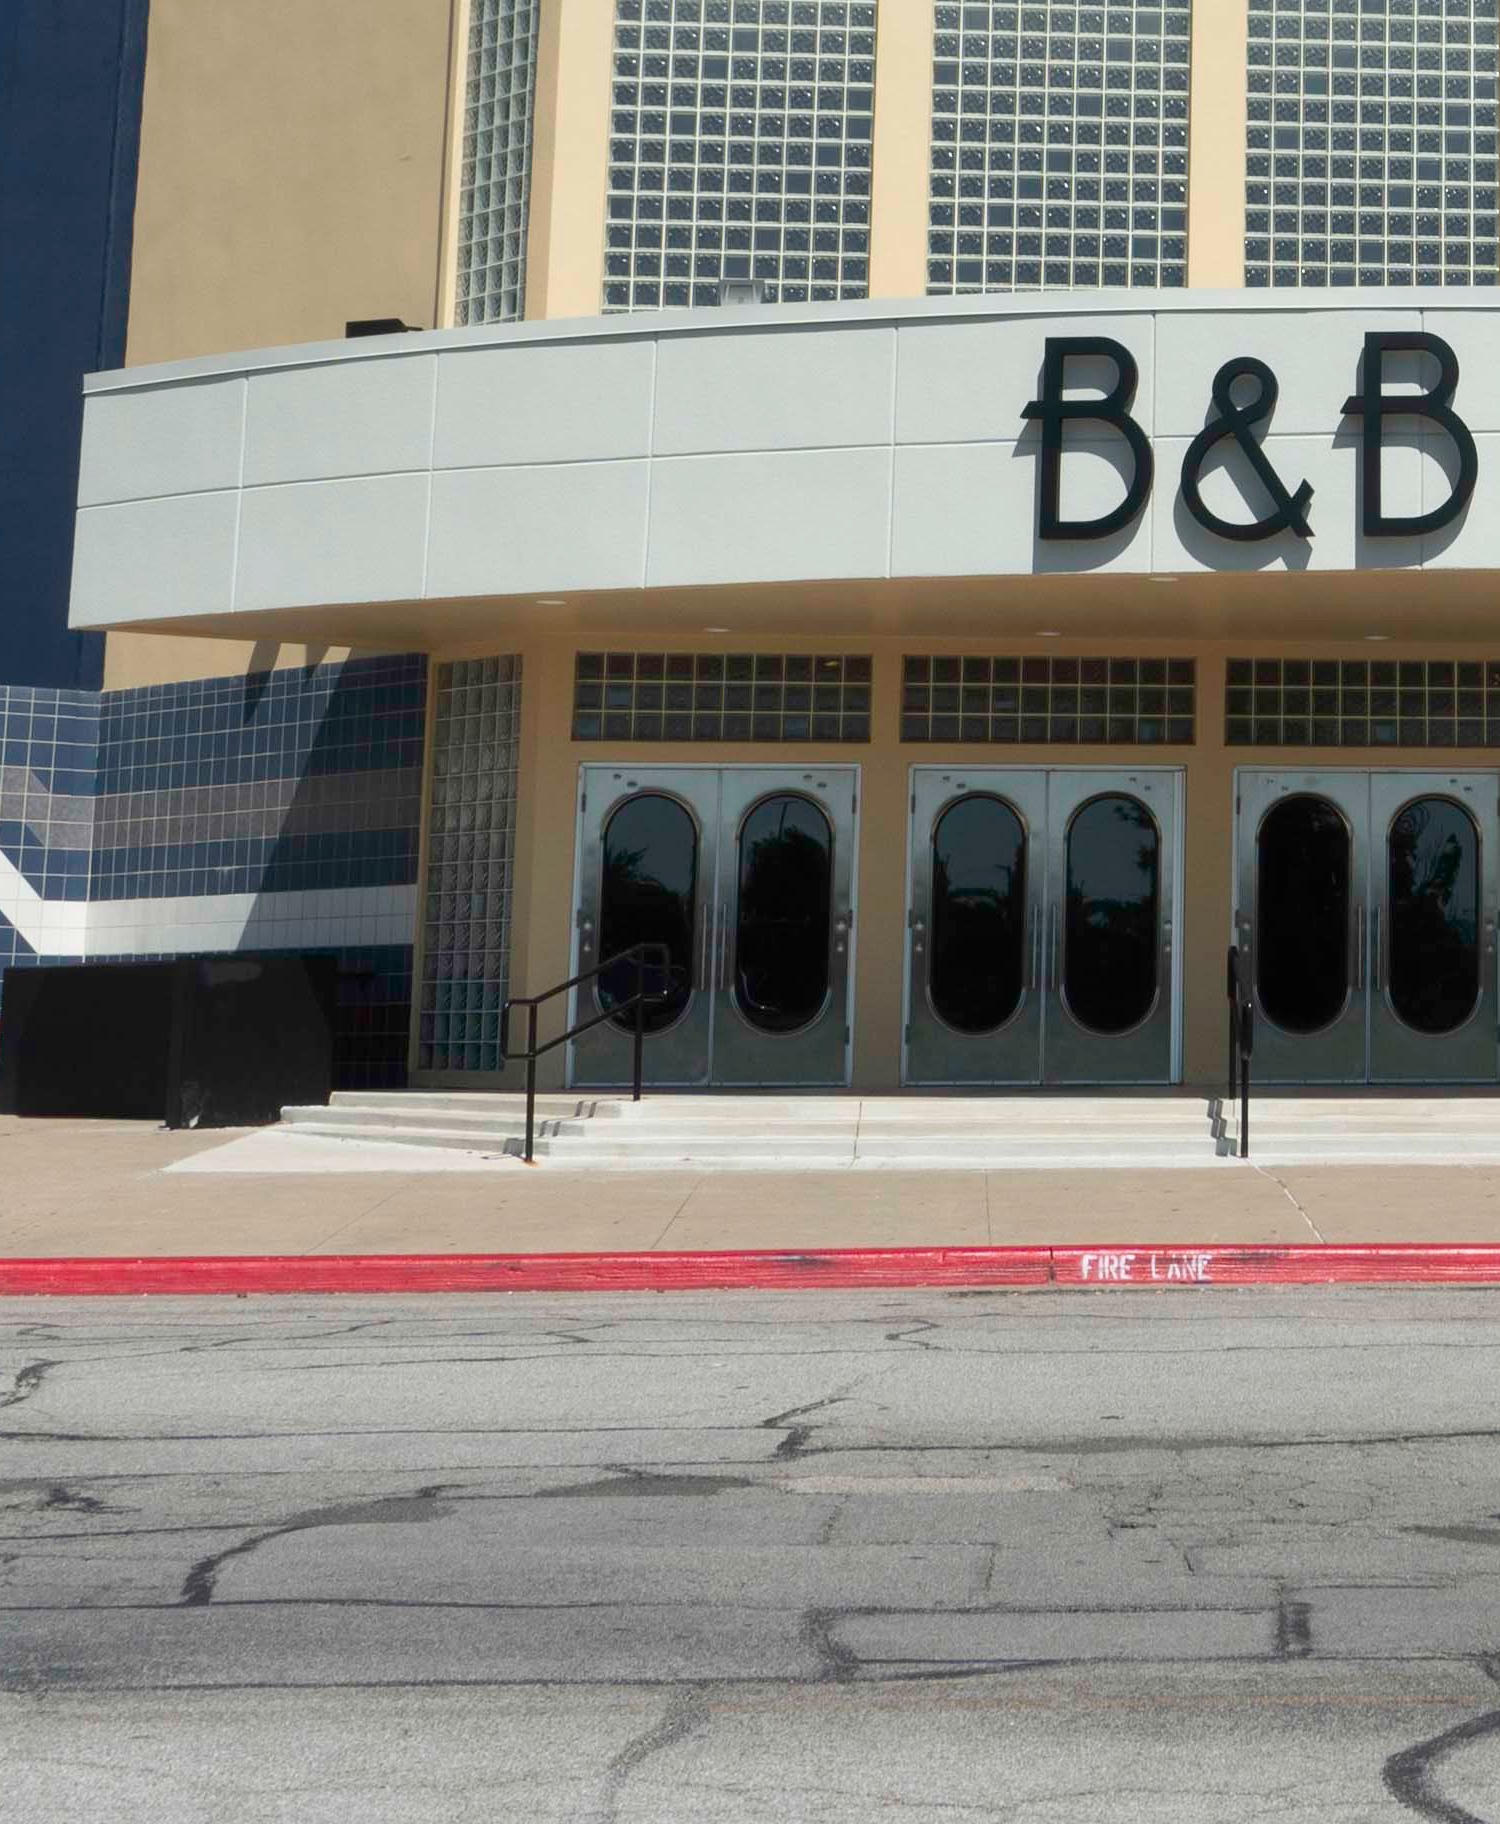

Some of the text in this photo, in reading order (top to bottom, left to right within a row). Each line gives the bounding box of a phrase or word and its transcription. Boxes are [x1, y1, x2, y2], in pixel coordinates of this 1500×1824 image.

[1020, 332, 1479, 542] B&B
[1080, 1254, 1212, 1281] FIRE LANE
